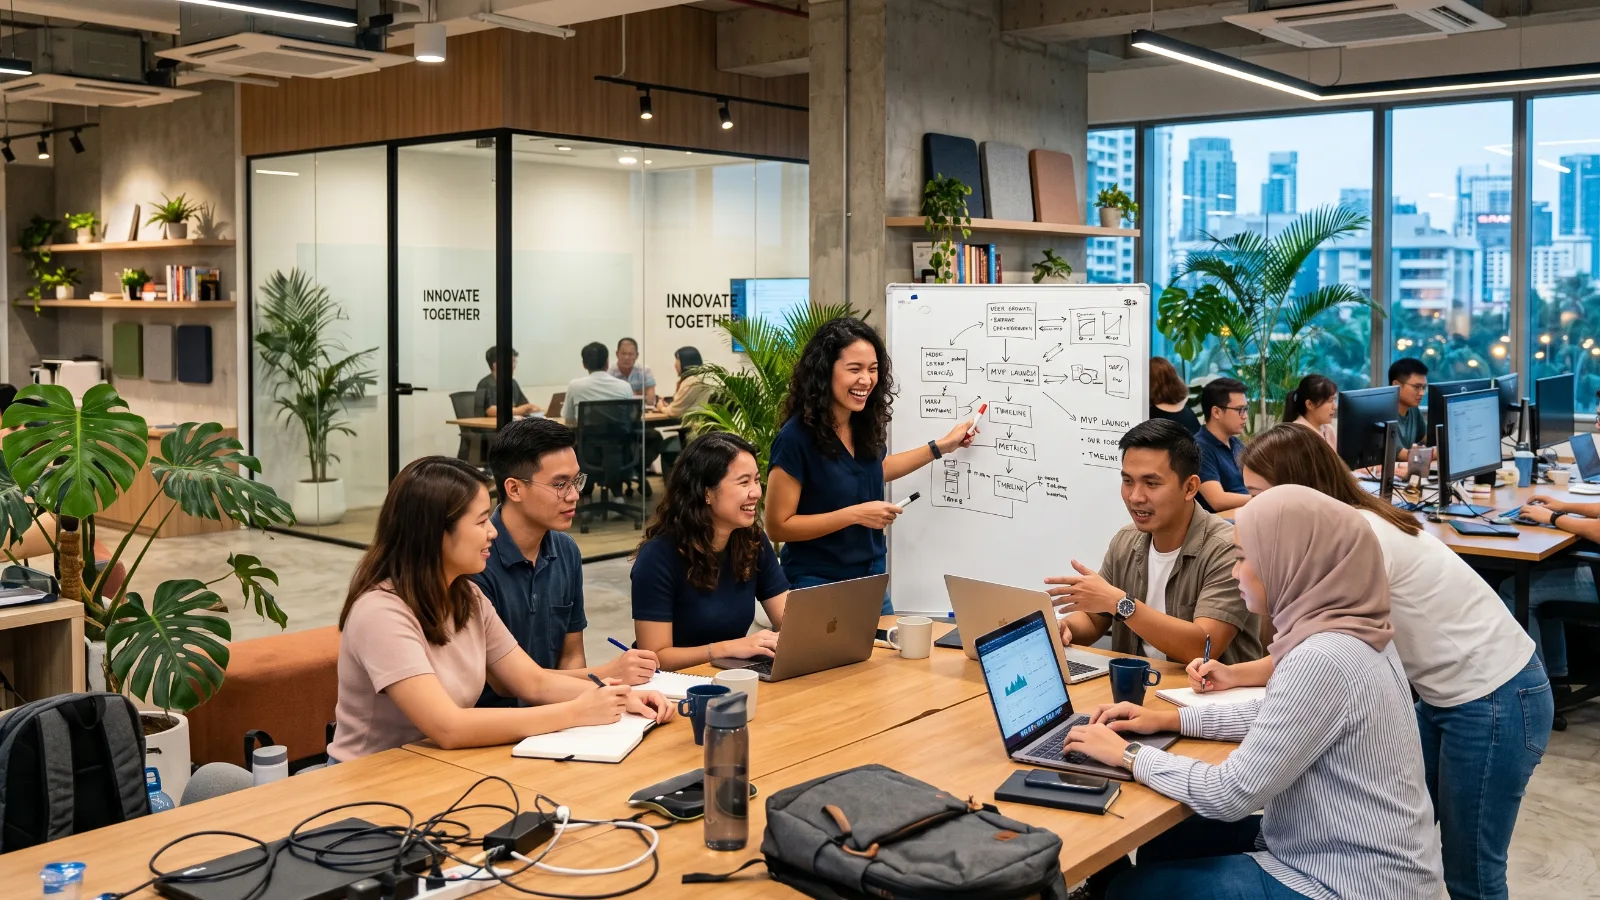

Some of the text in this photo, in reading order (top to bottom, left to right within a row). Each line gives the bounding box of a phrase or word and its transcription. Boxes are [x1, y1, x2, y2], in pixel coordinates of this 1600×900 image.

[423, 289, 480, 302] INNOVATE
[667, 293, 738, 308] INNOVATE
[423, 308, 480, 320] TOGETHER
[990, 368, 1007, 376] MVP
[1080, 416, 1131, 428] MVP LAUNCH
[998, 442, 1028, 454] METRICS
